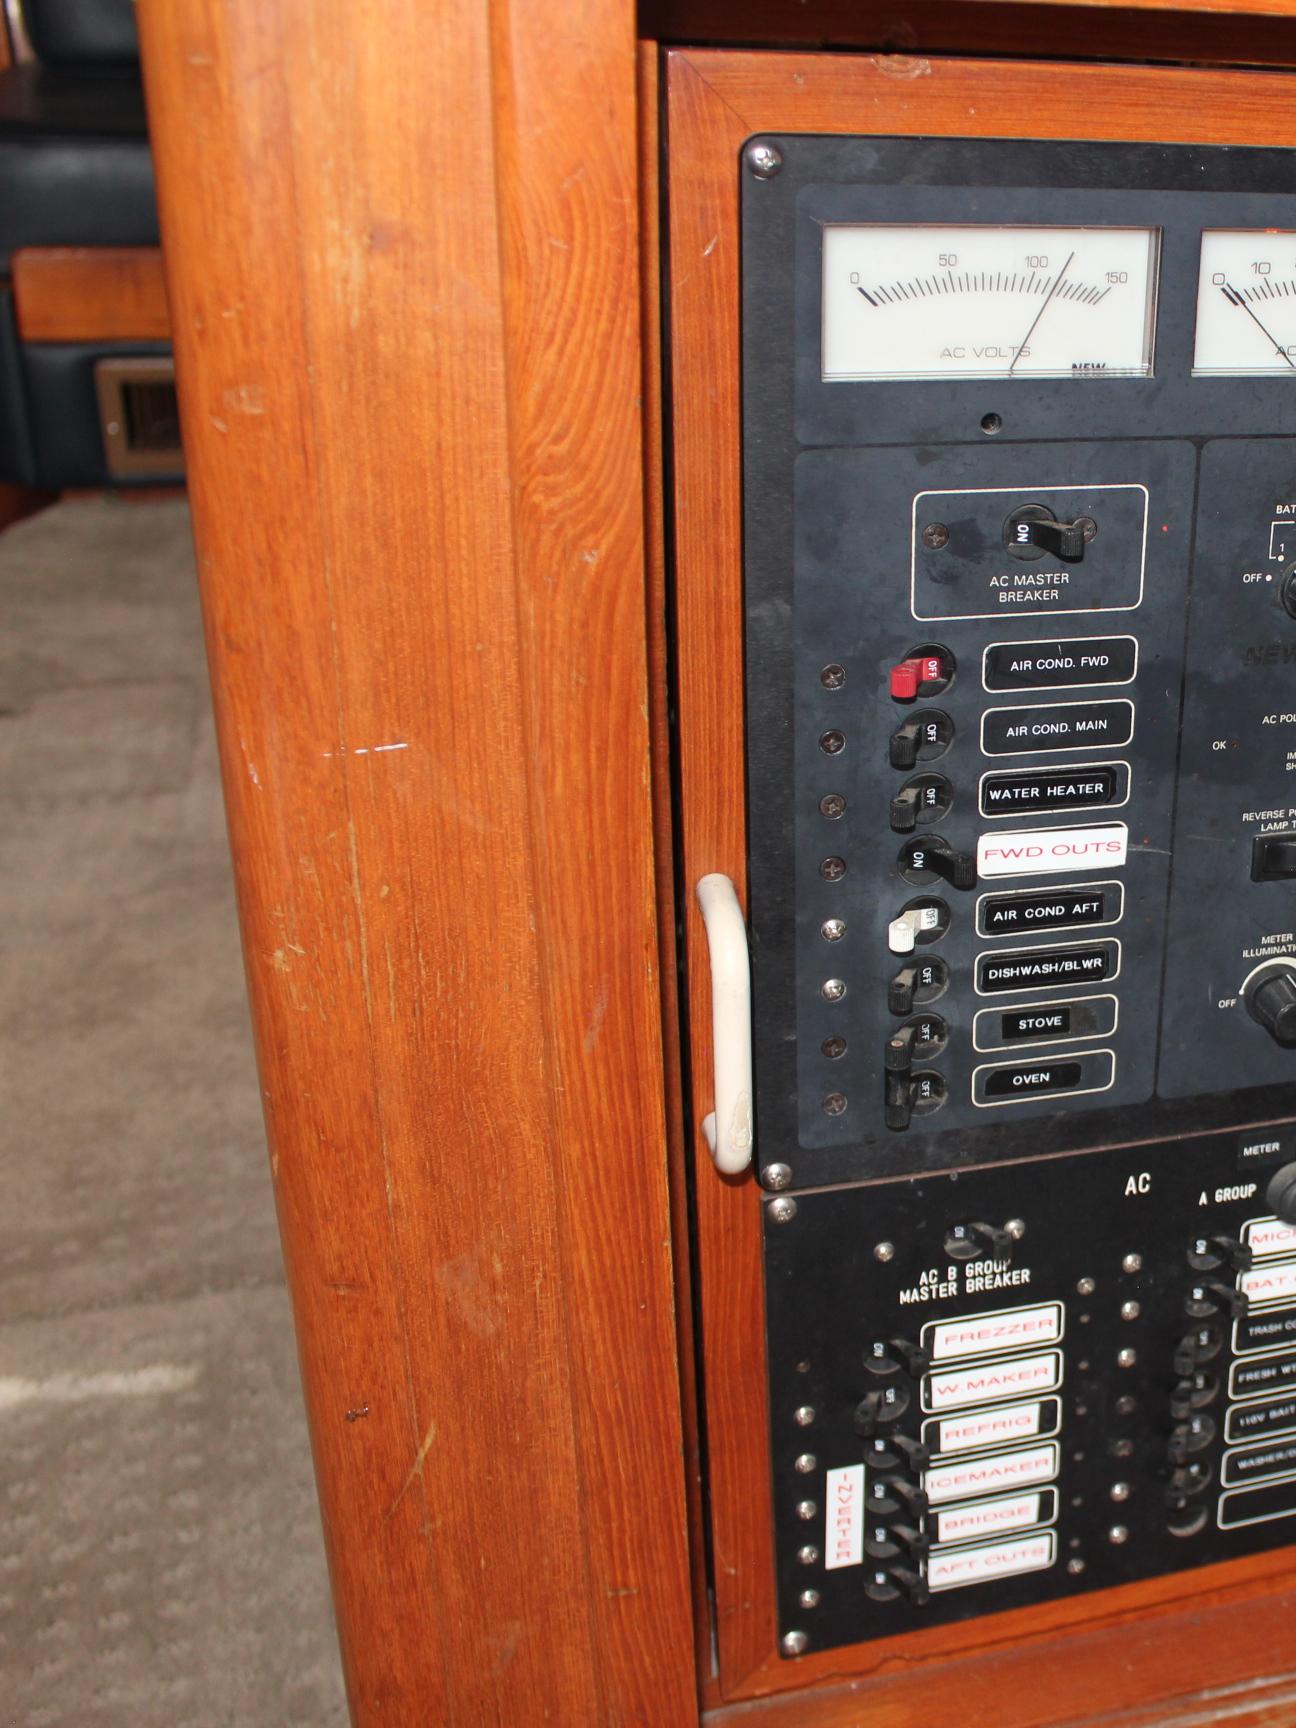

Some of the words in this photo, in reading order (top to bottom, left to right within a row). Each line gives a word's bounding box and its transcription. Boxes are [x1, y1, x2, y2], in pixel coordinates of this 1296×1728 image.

[938, 255, 957, 266] 50
[1025, 256, 1048, 268] 100
[1251, 262, 1271, 274] 10
[850, 272, 859, 284] 0
[1105, 272, 1129, 284] 150
[1213, 273, 1225, 285] 0
[940, 347, 965, 358] AC
[973, 346, 1031, 358] VOLTS
[1017, 524, 1029, 542] ON
[989, 576, 1009, 587] AC
[1014, 573, 1069, 586] MASTER
[1242, 573, 1263, 583] OFF
[999, 590, 1059, 603] BREAKER
[1010, 659, 1032, 671] AIR
[1036, 656, 1076, 670] COND.
[1081, 655, 1109, 667] FWD
[1262, 715, 1277, 724] AC
[1006, 726, 1028, 737] AIR
[1032, 723, 1071, 736] COND.
[1076, 720, 1107, 731] MAIN
[1212, 741, 1226, 751] OK
[989, 787, 1040, 800] WATER
[1047, 783, 1104, 796] HEATER
[1242, 810, 1285, 822] REVERSE
[1261, 821, 1289, 832] LAMP
[984, 842, 1044, 861] FWD
[1051, 841, 1121, 856] OUTS
[993, 910, 1017, 922] AIR
[1025, 906, 1065, 919] COND
[1072, 902, 1100, 914] AFT
[1261, 933, 1294, 944] METER
[988, 957, 1103, 979] DISHWASH/BLWR
[1218, 998, 1237, 1009] OFF
[1018, 1016, 1062, 1030] STOVE
[1012, 1073, 1050, 1086] OVEN
[1243, 1142, 1280, 1156] METER
[1125, 1172, 1151, 1196] AC
[1199, 1191, 1208, 1206] A
[1215, 1184, 1257, 1203] GROUP
[919, 1269, 938, 1286] AC
[948, 1265, 957, 1281] B
[900, 1282, 957, 1305] MASTER
[966, 1268, 1031, 1294] BREAKER
[931, 1458, 1049, 1489] ICEMAKER
